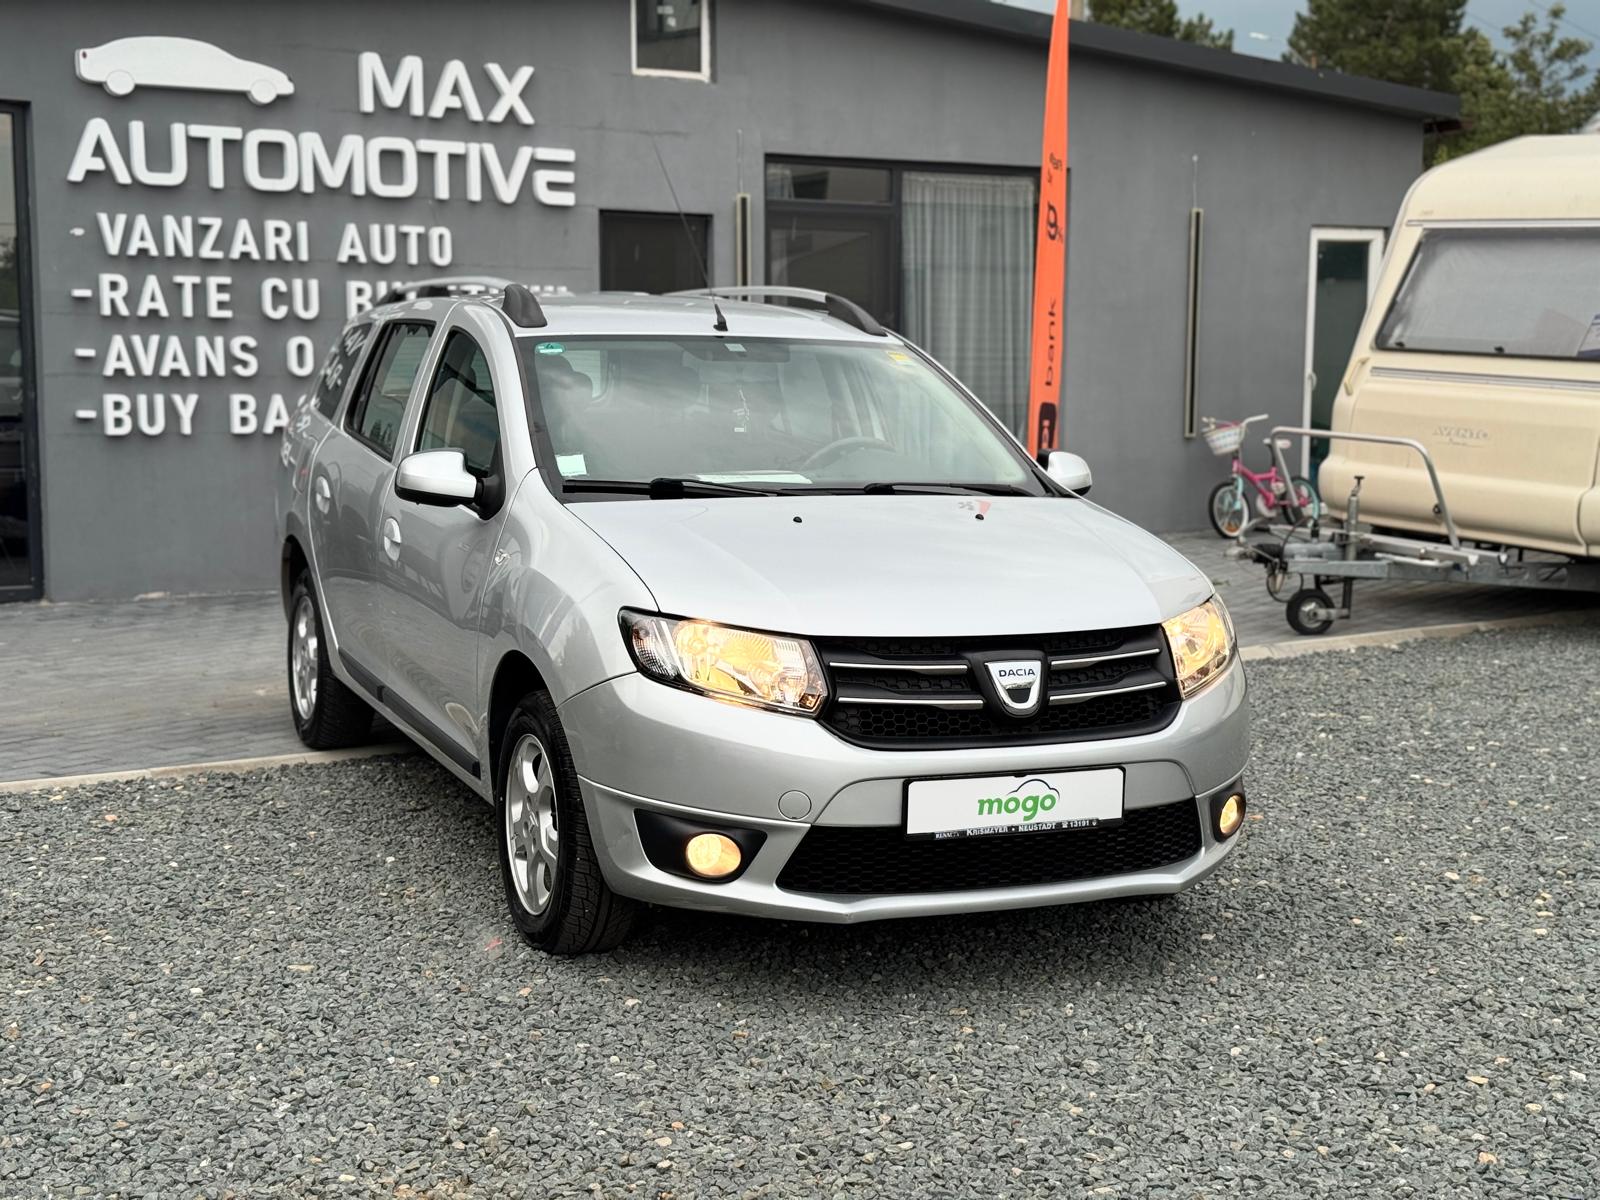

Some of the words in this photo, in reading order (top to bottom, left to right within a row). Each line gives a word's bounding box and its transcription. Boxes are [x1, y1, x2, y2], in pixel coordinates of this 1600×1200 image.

[358, 51, 535, 125] MAX
[66, 117, 576, 207] AUTOMOTIVE
[96, 212, 310, 262] VANZARI
[336, 223, 453, 267] AUTO
[260, 277, 320, 320] CU
[1044, 298, 1057, 387] bank
[229, 393, 290, 435] BA
[998, 668, 1036, 678] DACIA
[977, 793, 1057, 822] mogo
[1018, 822, 1057, 832] NEUSTADT
